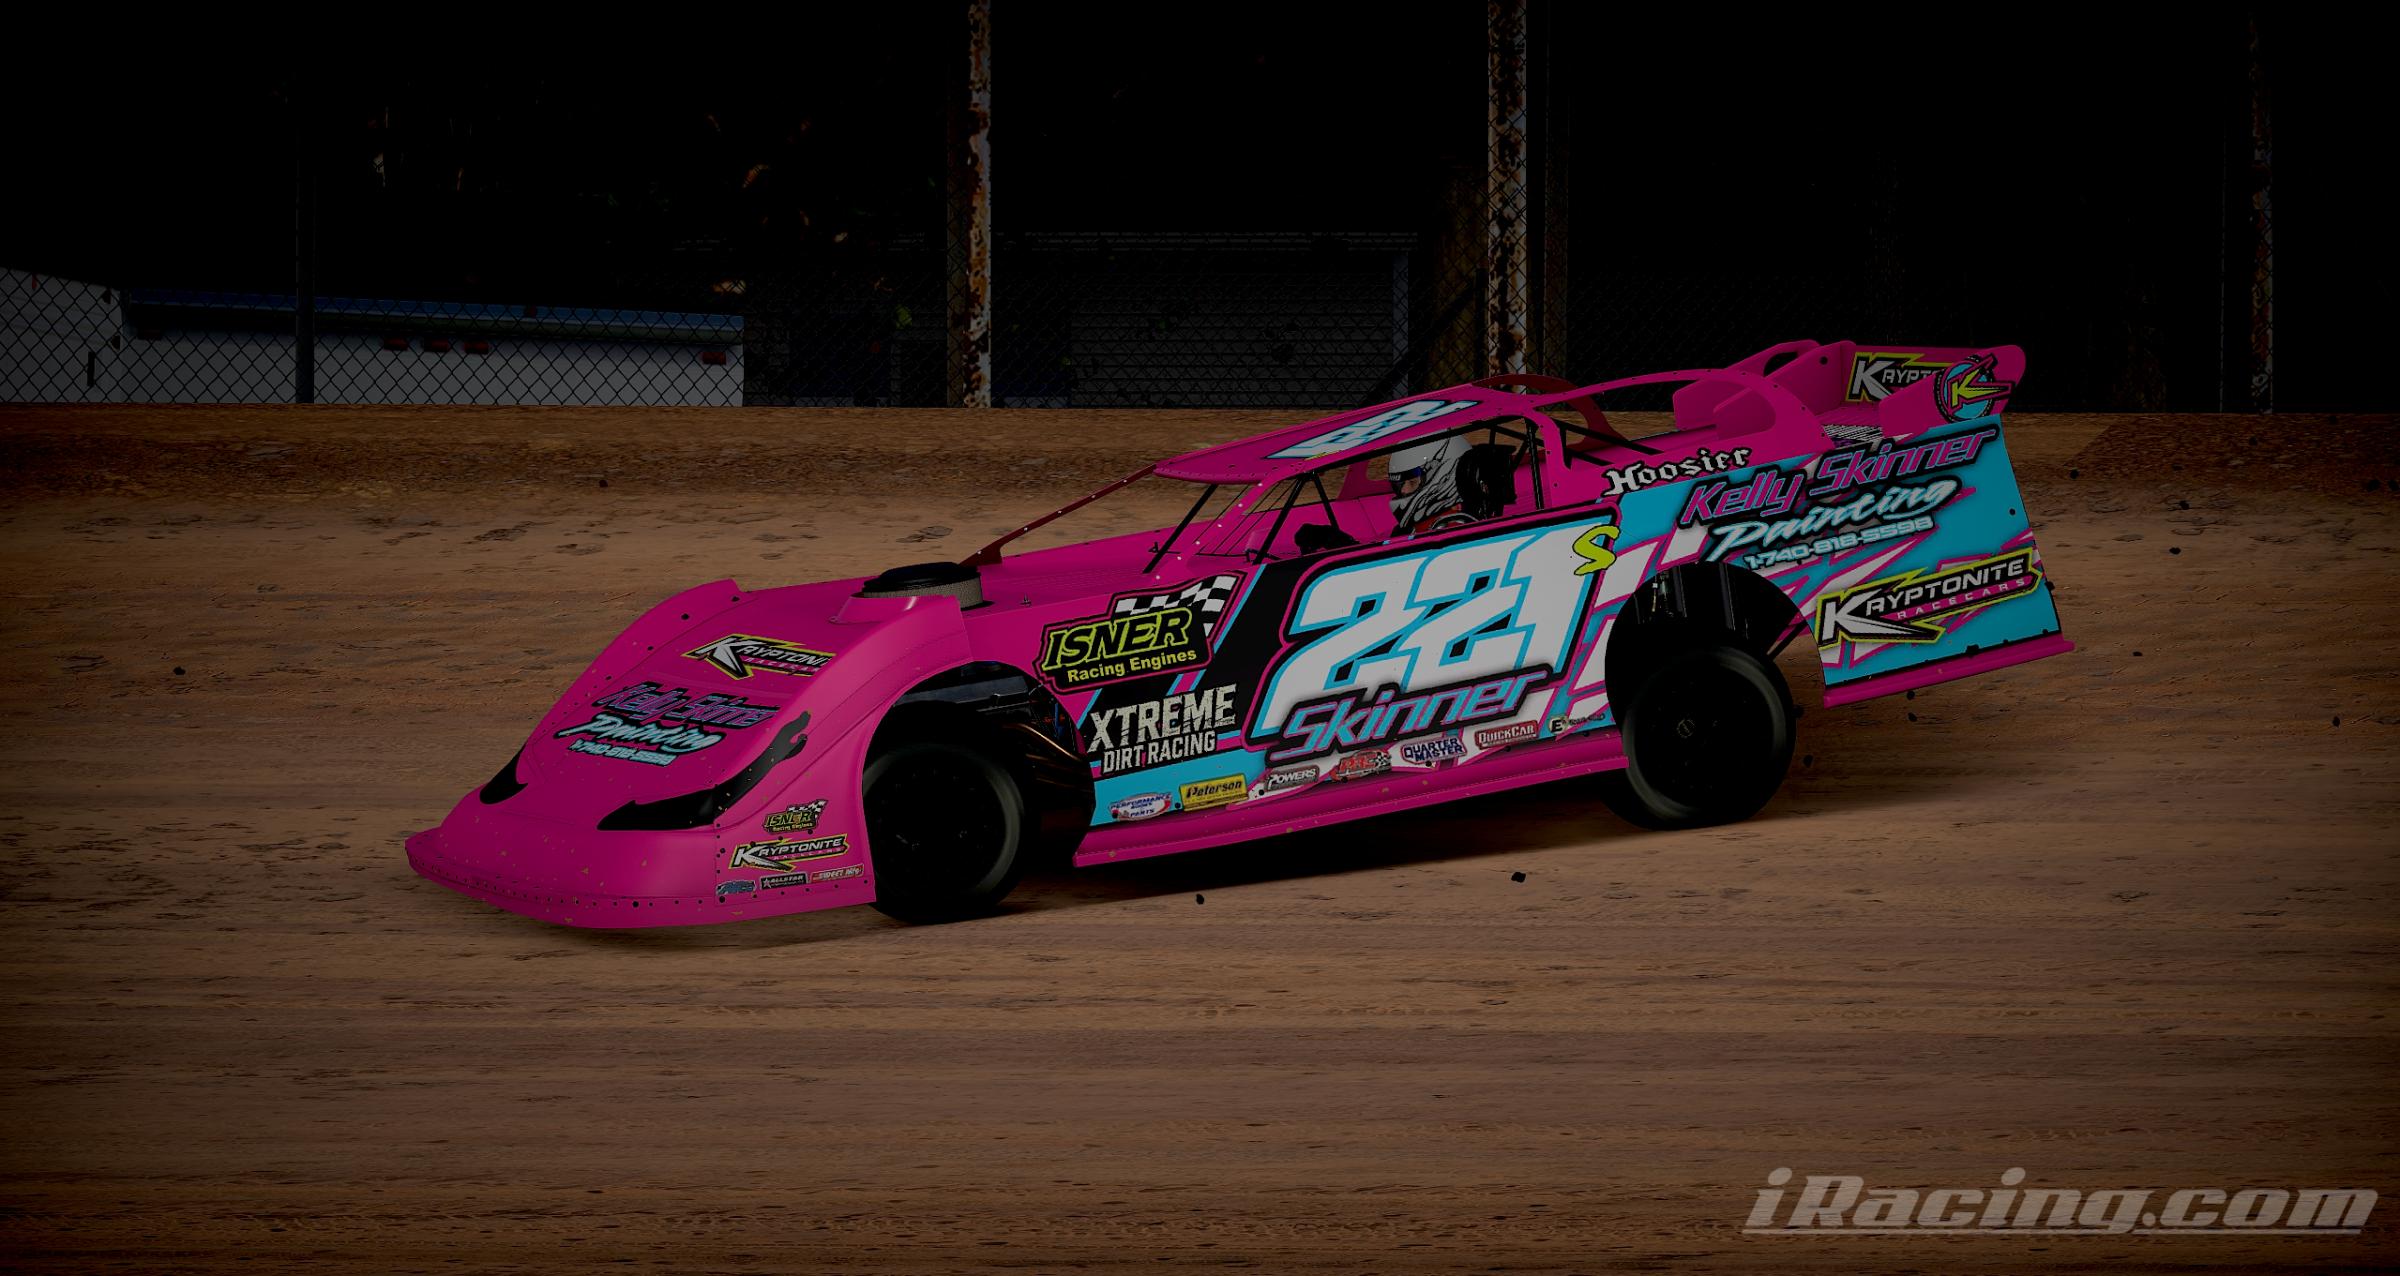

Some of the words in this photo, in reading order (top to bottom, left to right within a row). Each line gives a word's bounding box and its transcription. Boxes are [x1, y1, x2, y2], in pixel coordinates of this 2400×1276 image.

[1603, 449, 1752, 497] Hoosier
[1680, 466, 1806, 526] Kelly
[1809, 427, 1998, 497] Skinner
[1706, 478, 1959, 563] Painting
[1821, 557, 2025, 641] KRYPTONITE
[1897, 578, 2025, 620] RACECARS
[1041, 607, 1194, 671] ISNER
[1251, 514, 1613, 739] 221
[694, 637, 829, 676] KRYPTONI
[1067, 661, 1125, 683] Racing
[1129, 650, 1197, 673] Engines
[1087, 682, 1239, 752] XTREME
[1268, 670, 1550, 762] Skinner
[1103, 745, 1145, 774] DIRT
[1149, 730, 1216, 768] RACING
[1404, 738, 1459, 759] QUARTER
[1414, 744, 1463, 762] MASTER
[1186, 781, 1242, 798] Peterson
[1268, 769, 1317, 790] POWERS
[733, 837, 843, 871] KRYPTONITE
